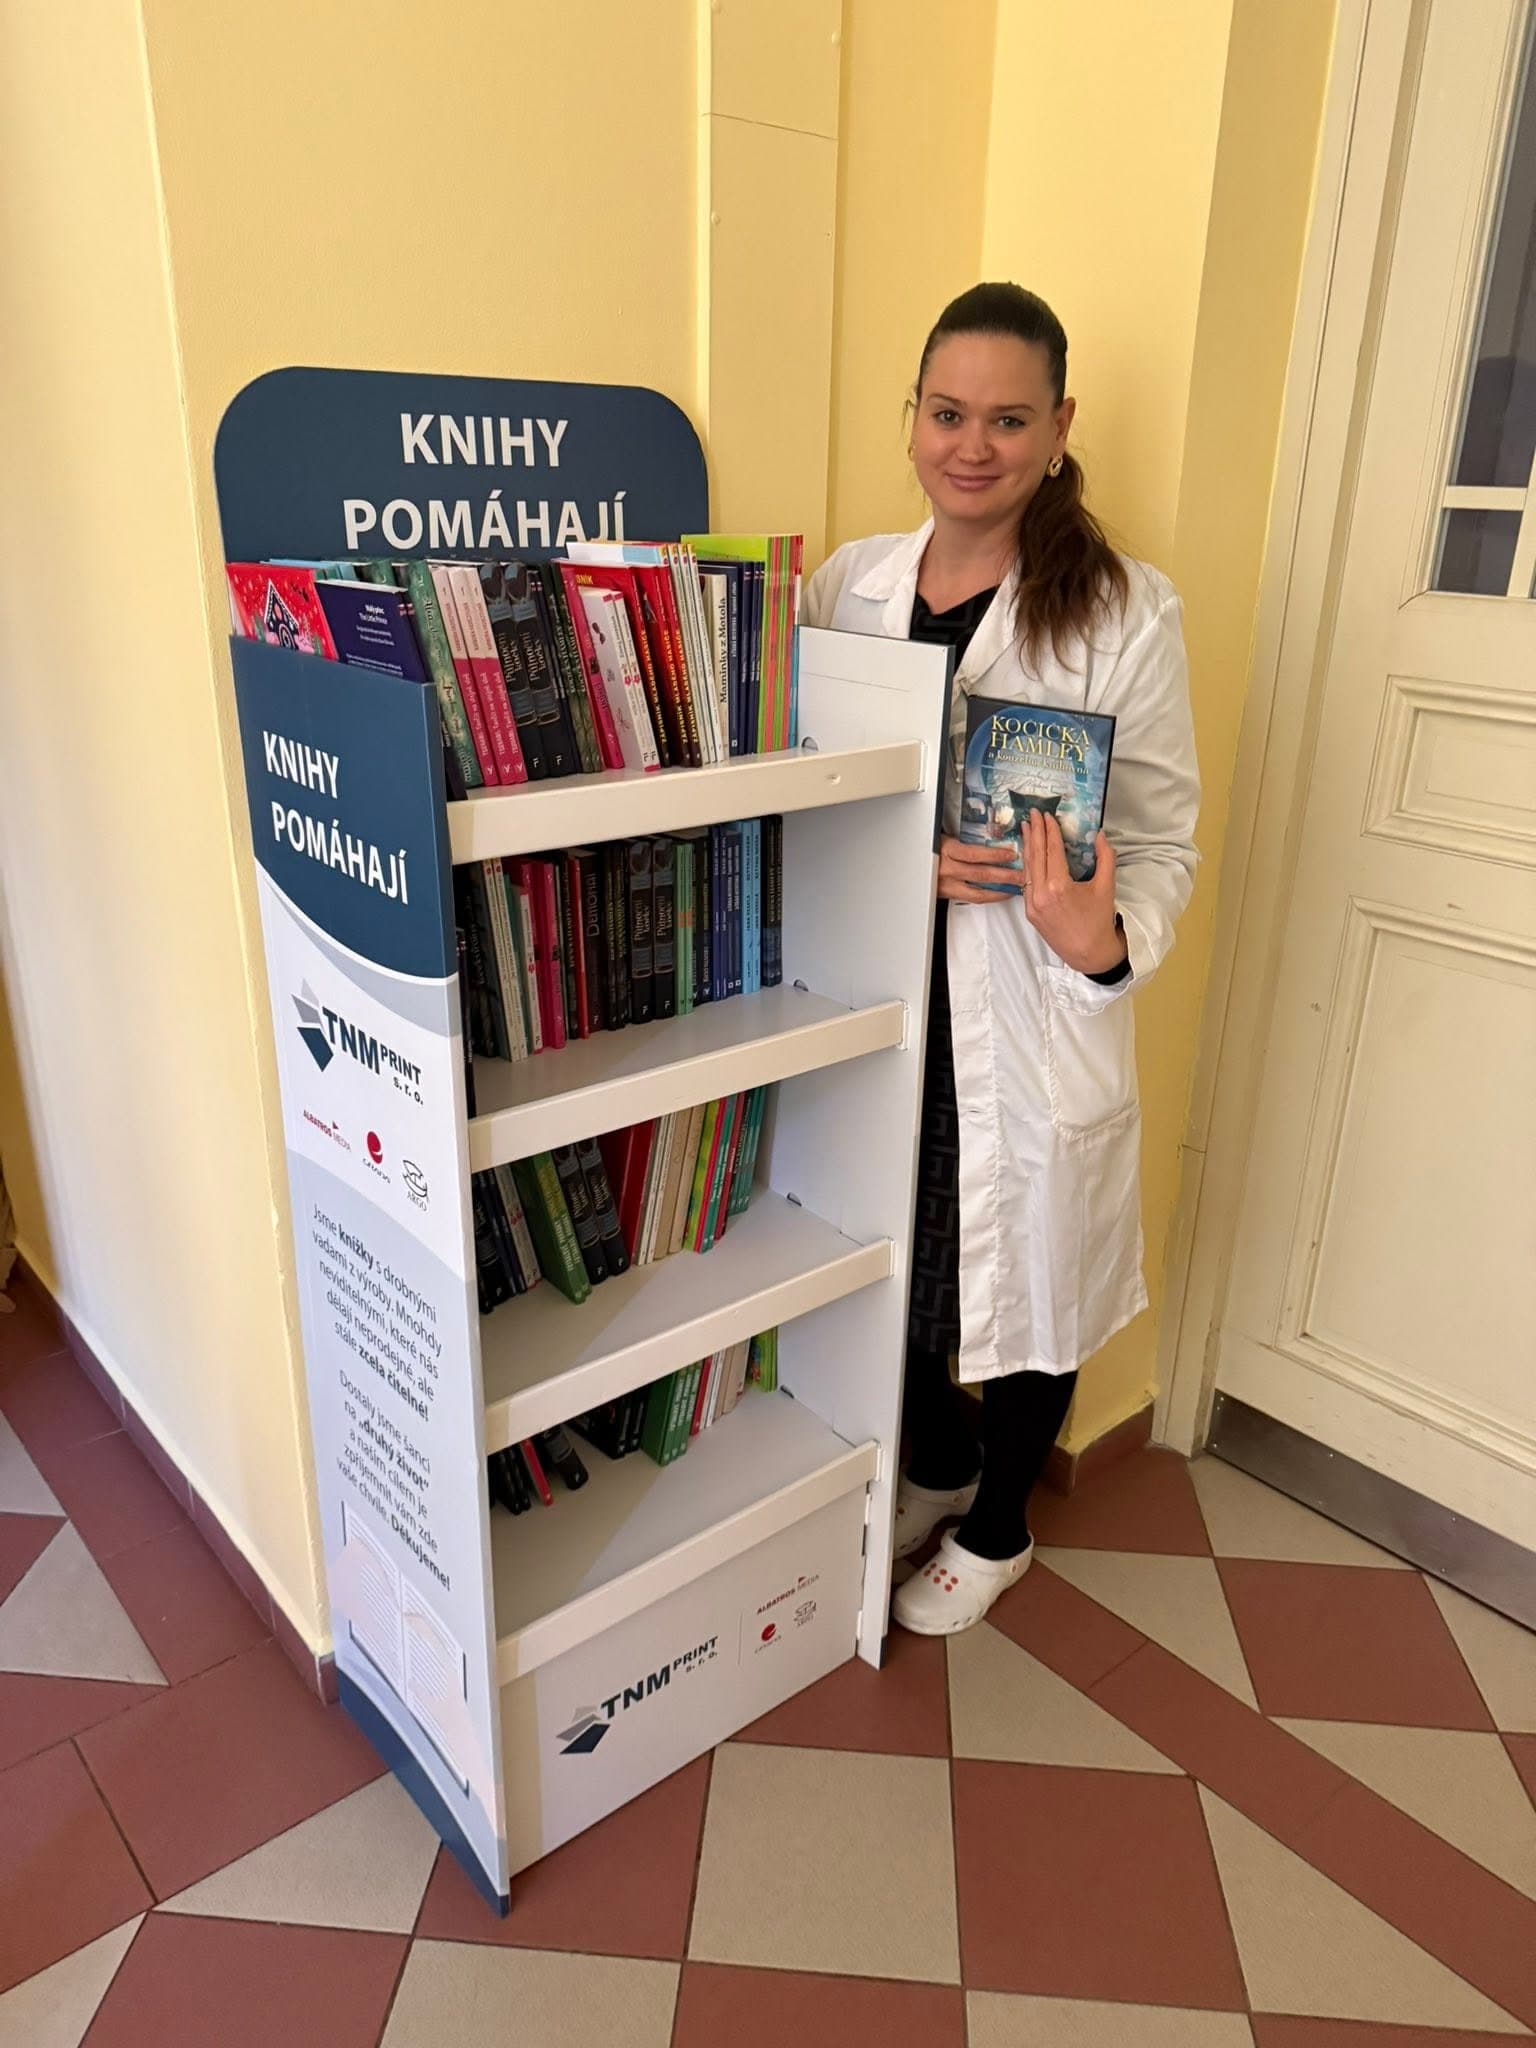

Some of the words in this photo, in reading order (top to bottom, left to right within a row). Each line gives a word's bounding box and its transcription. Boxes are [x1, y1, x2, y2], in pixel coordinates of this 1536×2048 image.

[400, 413, 569, 467] KNIHY
[343, 489, 626, 550] POMÁHAJÍ
[575, 574, 594, 585] SNÍK
[719, 597, 728, 638] Motola
[720, 639, 727, 648] z
[719, 649, 728, 703] Maminky
[263, 731, 339, 799] KNIHY
[991, 731, 1089, 763] HAMLEY
[271, 801, 409, 905] POMÁHAJÍ
[322, 1006, 380, 1075] TNM
[380, 1044, 421, 1085] PRINT
[303, 1110, 332, 1138] ALBATROS
[393, 1077, 402, 1090] s.
[404, 1085, 412, 1097] r.
[414, 1091, 424, 1105] o.
[313, 1230, 347, 1270] vadami
[350, 1262, 355, 1277] z
[357, 1268, 394, 1313] výroby.
[396, 1300, 442, 1357] Mnohdy
[314, 1204, 337, 1236] Jsme
[339, 1224, 373, 1270] knížky
[376, 1261, 382, 1274] s
[384, 1265, 437, 1323] drobnými
[320, 1260, 388, 1335] neviditelnými,
[390, 1319, 417, 1359] které
[419, 1352, 438, 1379] nás
[327, 1288, 352, 1325] dělají
[355, 1316, 415, 1385] neprodejné,
[418, 1376, 434, 1401] ale
[335, 1322, 356, 1351] stále
[359, 1345, 385, 1379] zcela
[387, 1368, 428, 1422] čitelné!
[340, 1369, 375, 1419] Dostaly
[377, 1407, 401, 1443] jsme
[403, 1435, 430, 1474] šanci
[345, 1400, 356, 1420] na
[344, 1443, 392, 1506] zpříjemnit
[394, 1498, 416, 1531] vám
[419, 1524, 437, 1554] zde
[350, 1429, 355, 1441] a
[388, 1470, 415, 1506] cílem
[418, 1496, 427, 1519] je
[336, 1457, 357, 1488] vaše
[391, 1513, 450, 1591] Děkujeme!
[757, 1588, 795, 1615] ALBATROS
[601, 1664, 670, 1719] TNM
[673, 1636, 718, 1671] PRINT
